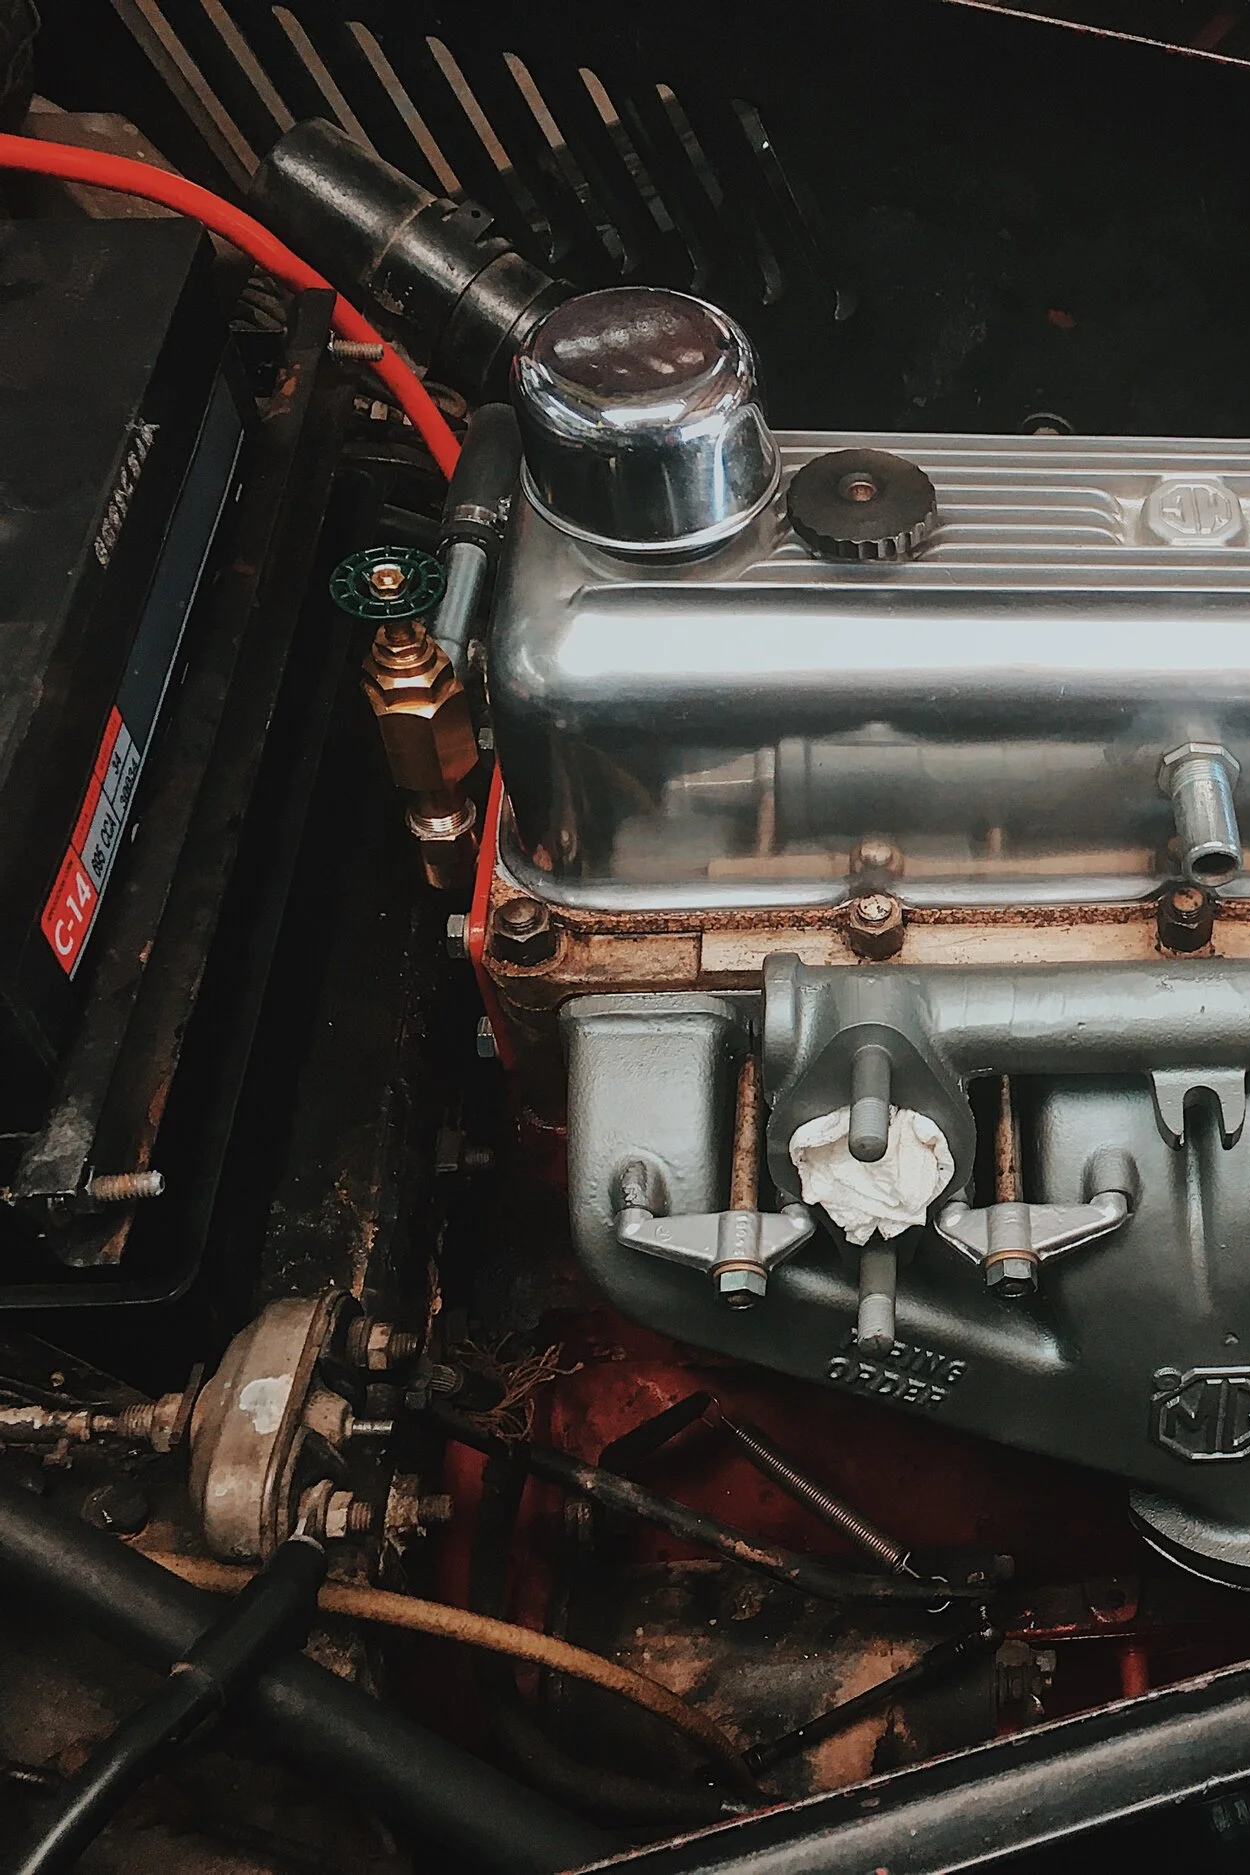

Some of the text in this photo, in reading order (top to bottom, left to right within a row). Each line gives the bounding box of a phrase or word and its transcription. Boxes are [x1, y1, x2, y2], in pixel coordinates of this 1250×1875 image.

[100, 812, 117, 849] CCA
[55, 871, 92, 956] C-14
[827, 1356, 949, 1412] ORDER
